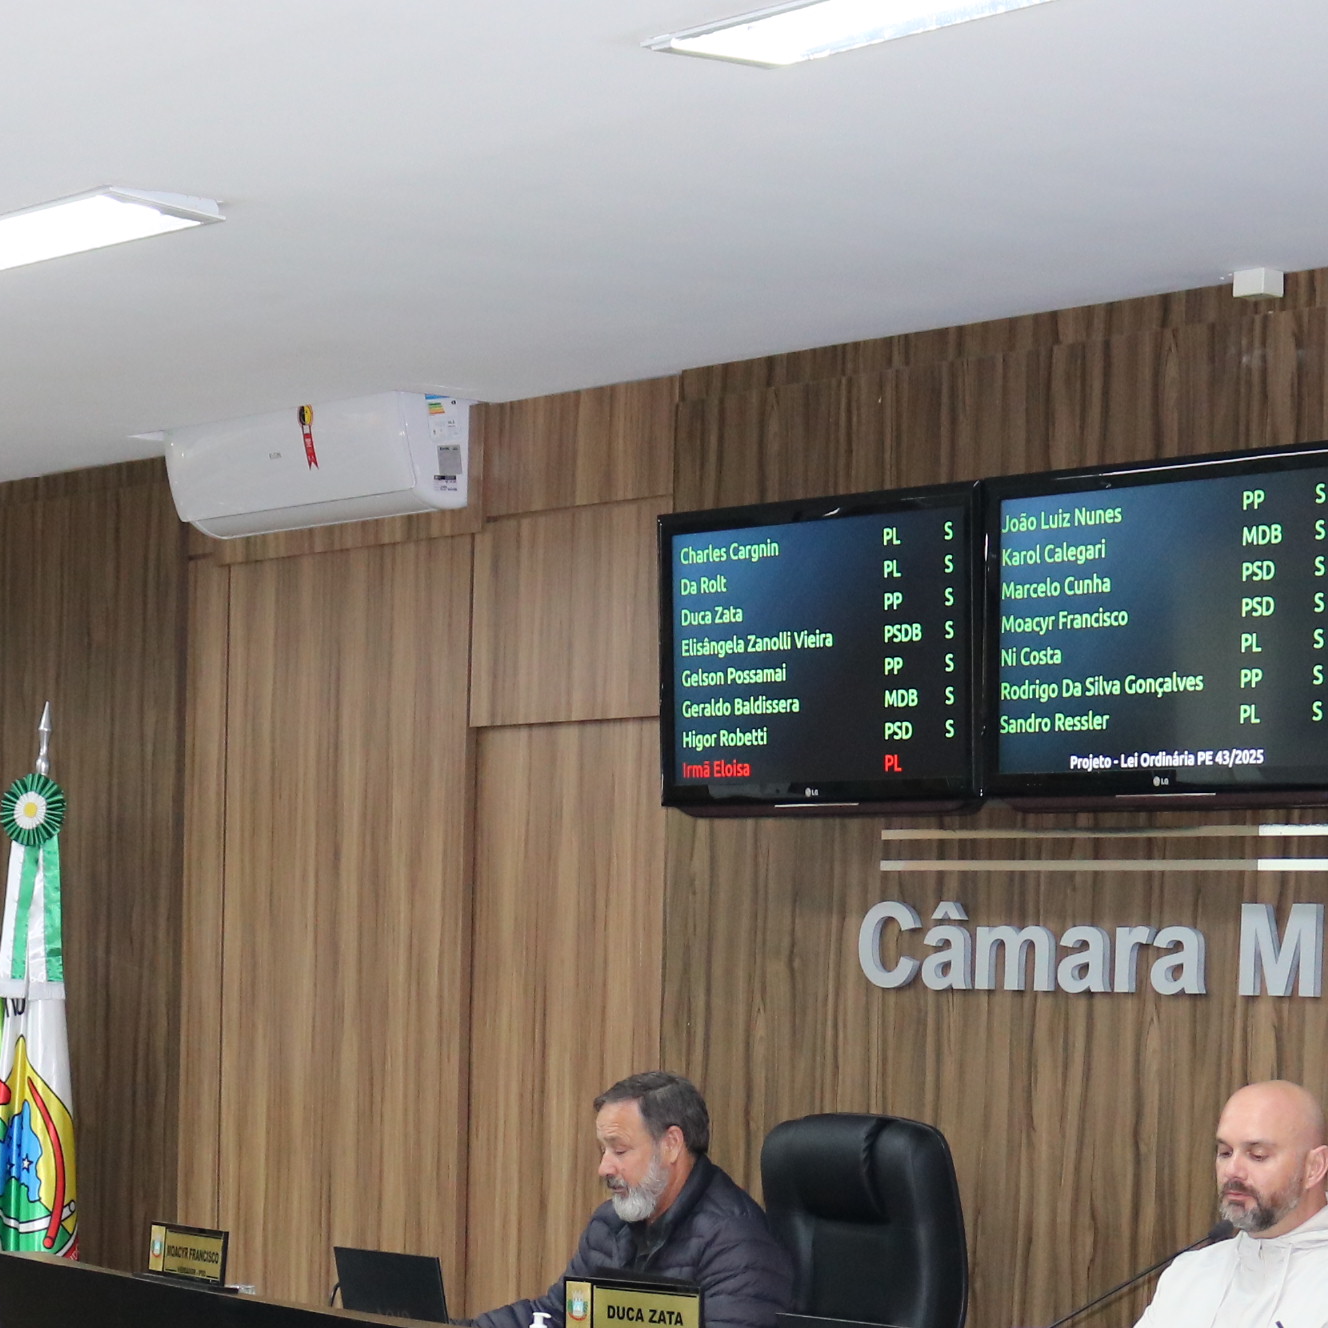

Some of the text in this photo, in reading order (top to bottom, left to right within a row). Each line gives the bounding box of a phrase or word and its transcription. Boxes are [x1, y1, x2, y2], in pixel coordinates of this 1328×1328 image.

[1001, 483, 1326, 533] João Luiz Nunes PP S
[680, 521, 954, 565] Charles Cargnin PL S
[1002, 519, 1326, 566] Karol Calegari MDB S
[680, 554, 954, 596] Da Rolt PL S
[1001, 555, 1325, 600] Marcelo Cunha PSD S
[681, 587, 954, 626] Duca Zata PP S
[1001, 592, 1325, 636] Moacyr Francisco PSD S
[681, 620, 954, 658] Elisângela Zanolli Vieira PSDB S
[1001, 628, 1325, 667] Ni Costa PL S
[681, 653, 954, 687] Gelson Possamai PP S
[1001, 664, 1324, 703] Rodrigo Da Silva Gonçalves PP S
[682, 686, 955, 718] Geraldo Baldissera MDB S
[999, 700, 1323, 734] Sandro Ressler PL S
[682, 719, 955, 752] Higor Robetti PSD S
[683, 754, 903, 778] Irmã Eloisa PL
[1070, 753, 1112, 772] Projeto
[1120, 751, 1139, 768] Lei
[1139, 750, 1196, 768] Ordinária
[1197, 750, 1214, 766] PE
[1214, 748, 1264, 768] 43/2025
[858, 901, 1206, 995] Câmara
[189, 1248, 219, 1264] FRANCISCO
[607, 1304, 684, 1326] DUCA ZATA
